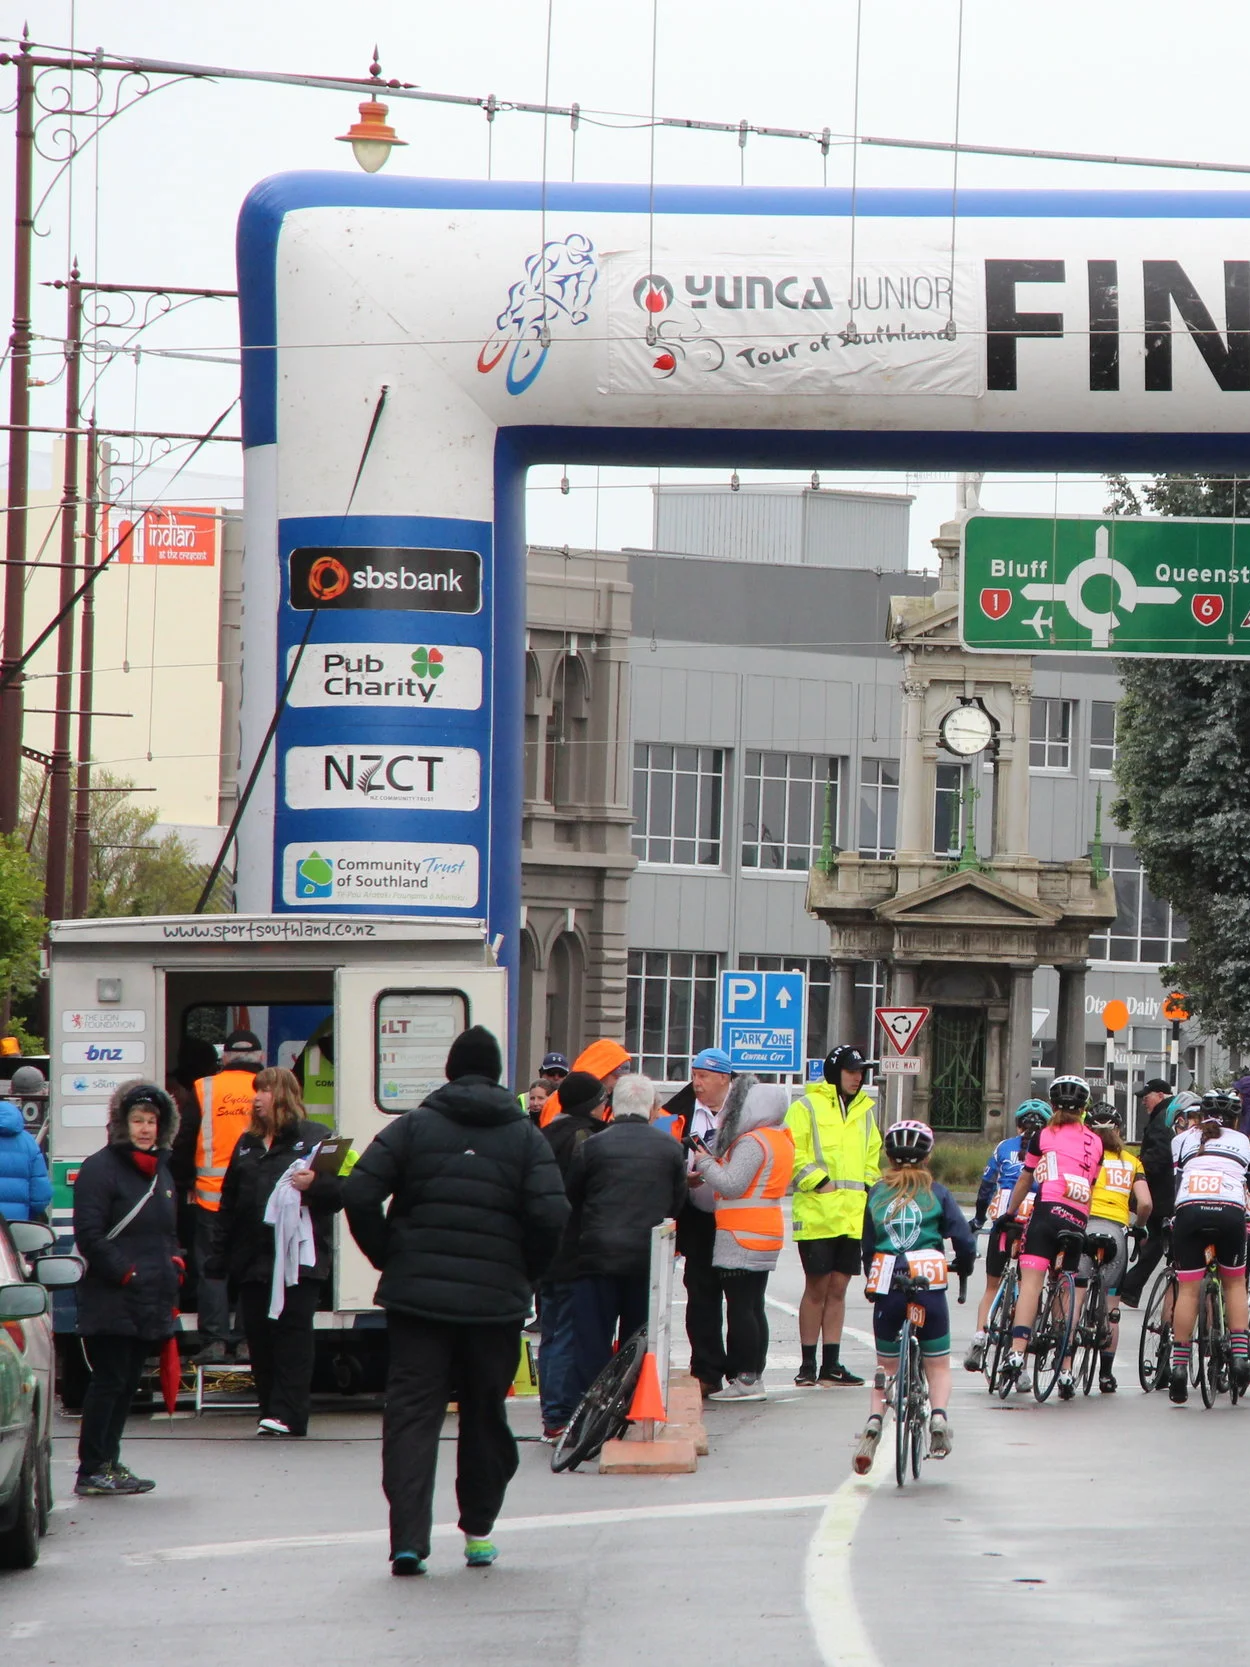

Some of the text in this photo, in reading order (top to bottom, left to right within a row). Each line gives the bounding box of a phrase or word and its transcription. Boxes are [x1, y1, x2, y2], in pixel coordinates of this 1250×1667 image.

[685, 275, 952, 310] YUNCA JUNIOR
[736, 322, 956, 369] Tour of Southland
[149, 511, 196, 547] indian
[991, 559, 1048, 579] Bluff
[992, 593, 1000, 611] 1
[1201, 598, 1214, 617] 6
[324, 654, 384, 673] Pub
[324, 677, 437, 703] Charity
[324, 755, 444, 795] NZCT
[337, 857, 465, 874] Community Trust
[337, 875, 428, 888] of Southland
[163, 922, 376, 941] www.sportsouthland.co.nz
[728, 979, 757, 1014] P
[1126, 996, 1160, 1020] Daily
[85, 1045, 123, 1061] bnz
[884, 1061, 917, 1069] GIVE WAY
[92, 1081, 119, 1089] South
[1106, 1169, 1131, 1187] 164
[1190, 1176, 1219, 1192] 168
[1067, 1182, 1090, 1203] 165
[913, 1261, 945, 1283] 161
[909, 1307, 923, 1323] 161
